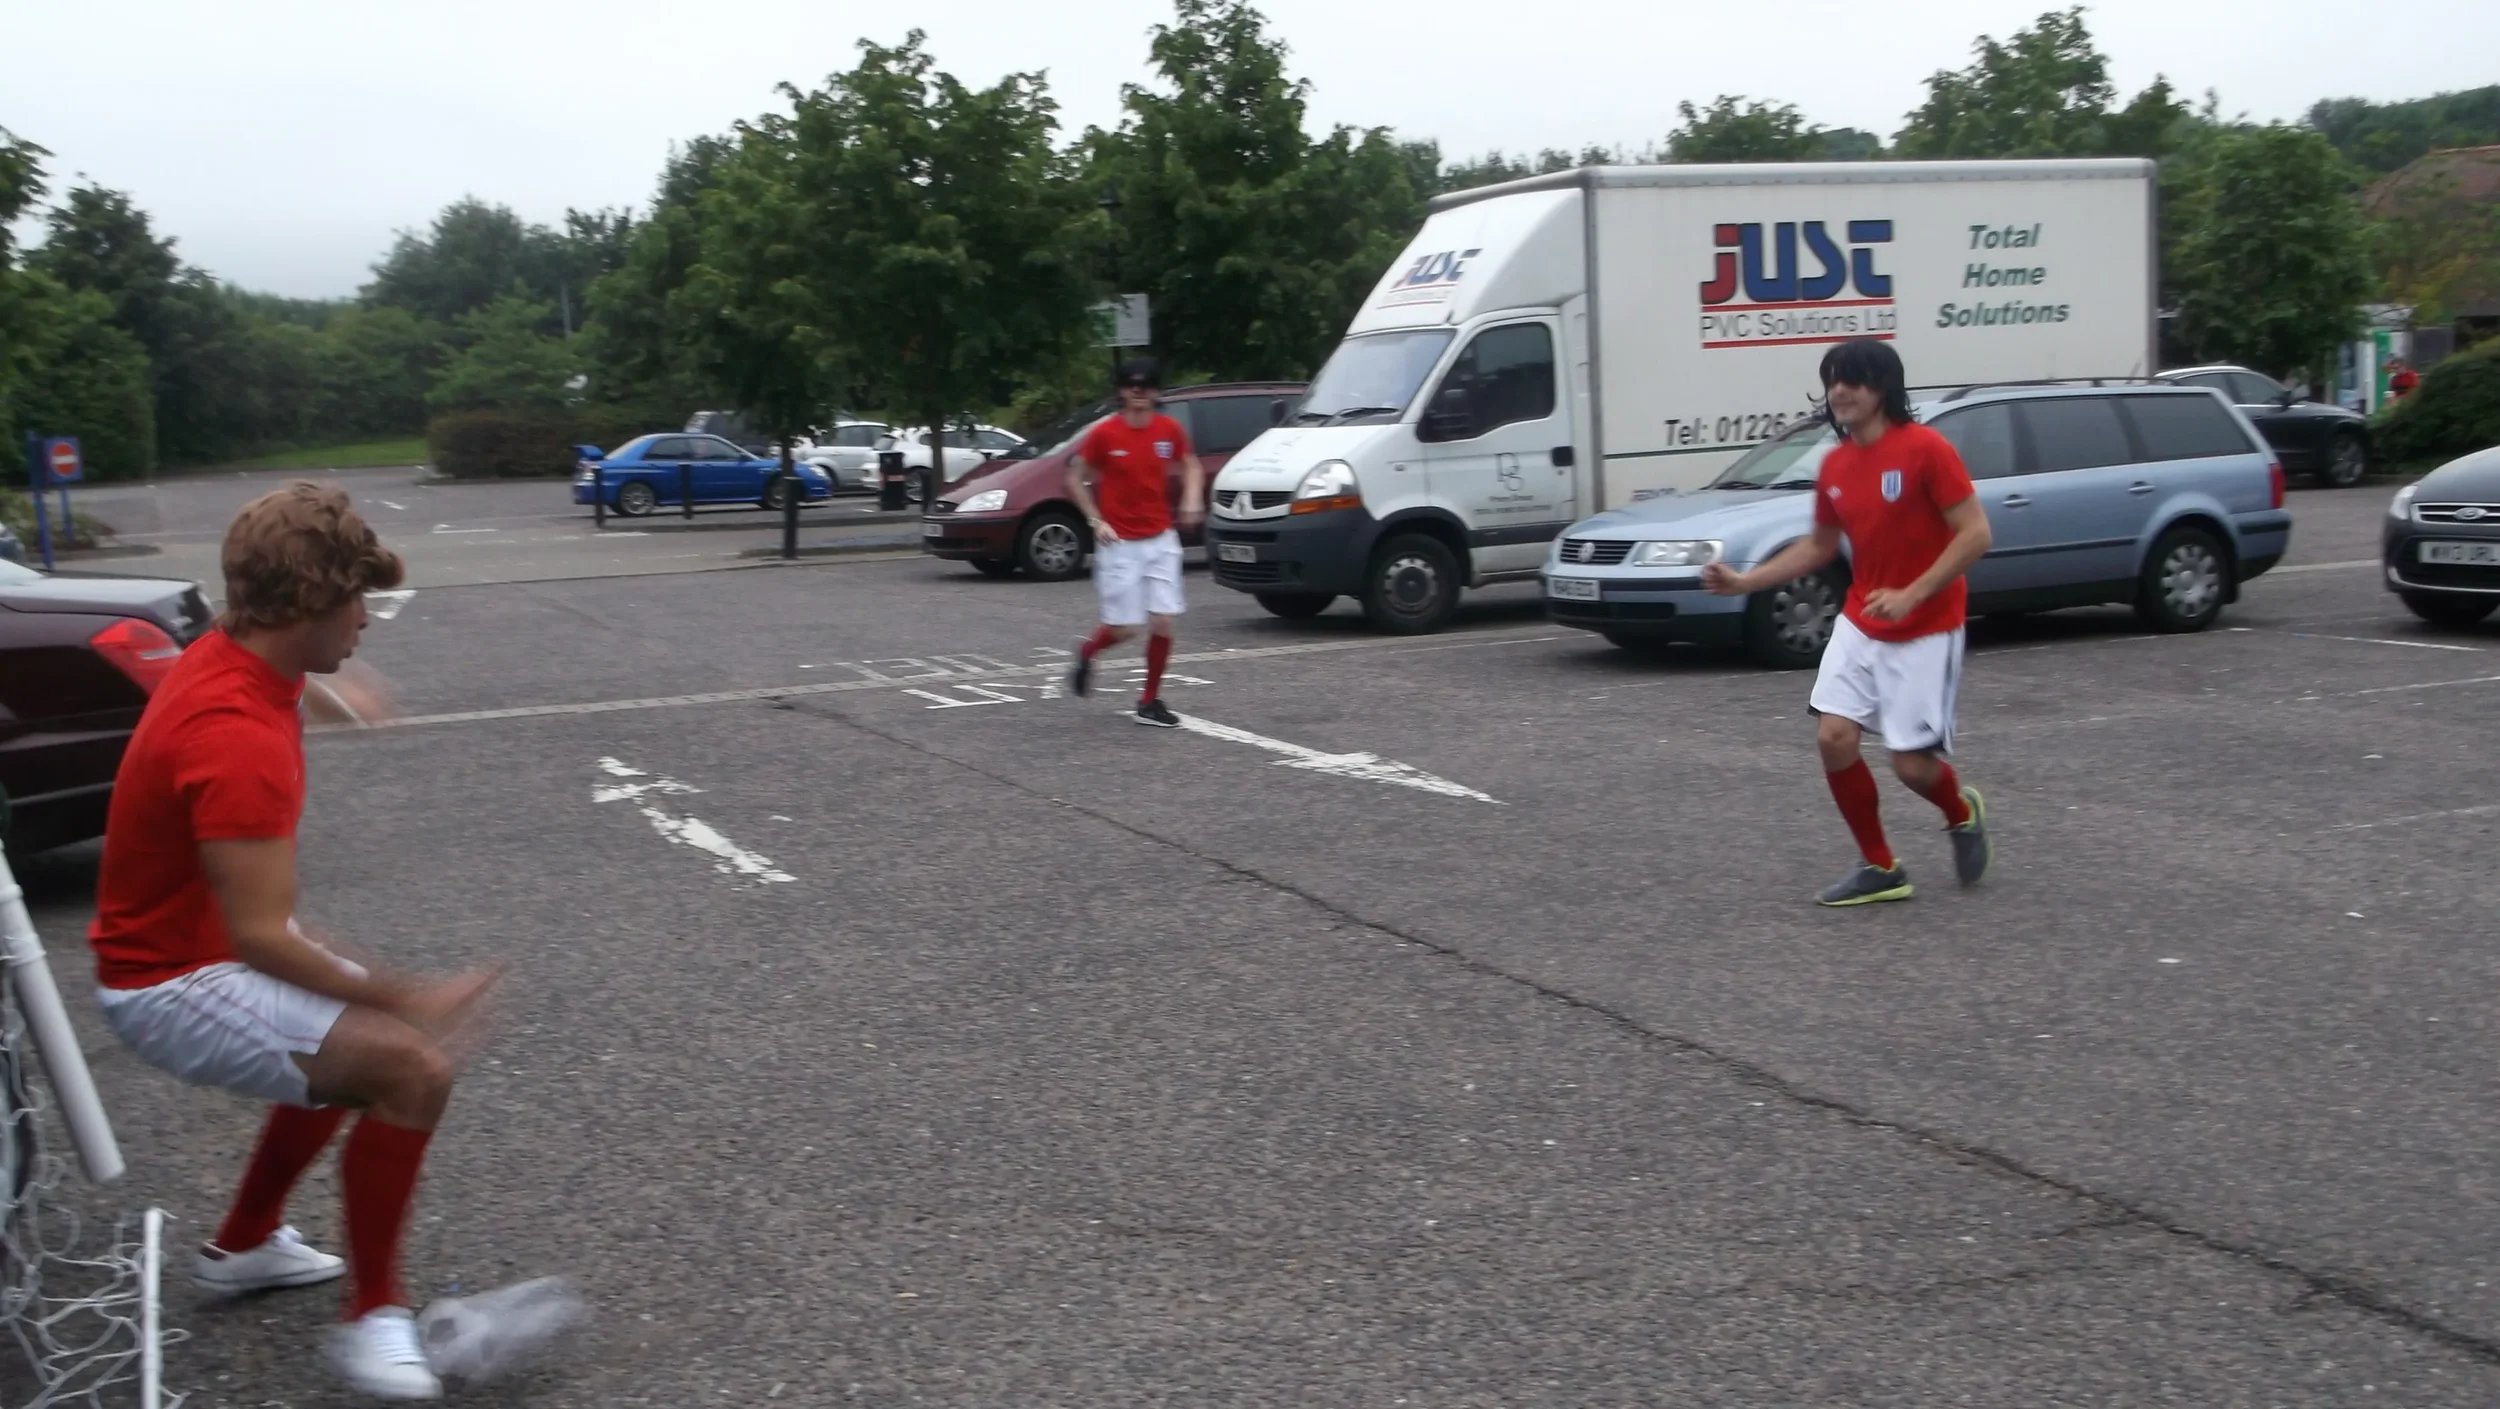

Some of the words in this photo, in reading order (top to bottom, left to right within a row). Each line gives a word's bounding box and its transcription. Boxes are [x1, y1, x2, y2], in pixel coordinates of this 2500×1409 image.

[1968, 222, 2042, 250] Total
[1961, 262, 2047, 288] Home
[1700, 314, 1751, 340] PVC
[1757, 309, 1858, 337] Solutions
[1863, 307, 1897, 333] Ltd
[1934, 300, 2071, 328] Solutions
[1664, 417, 1708, 446] Tel:
[1715, 411, 1787, 443] 01226
